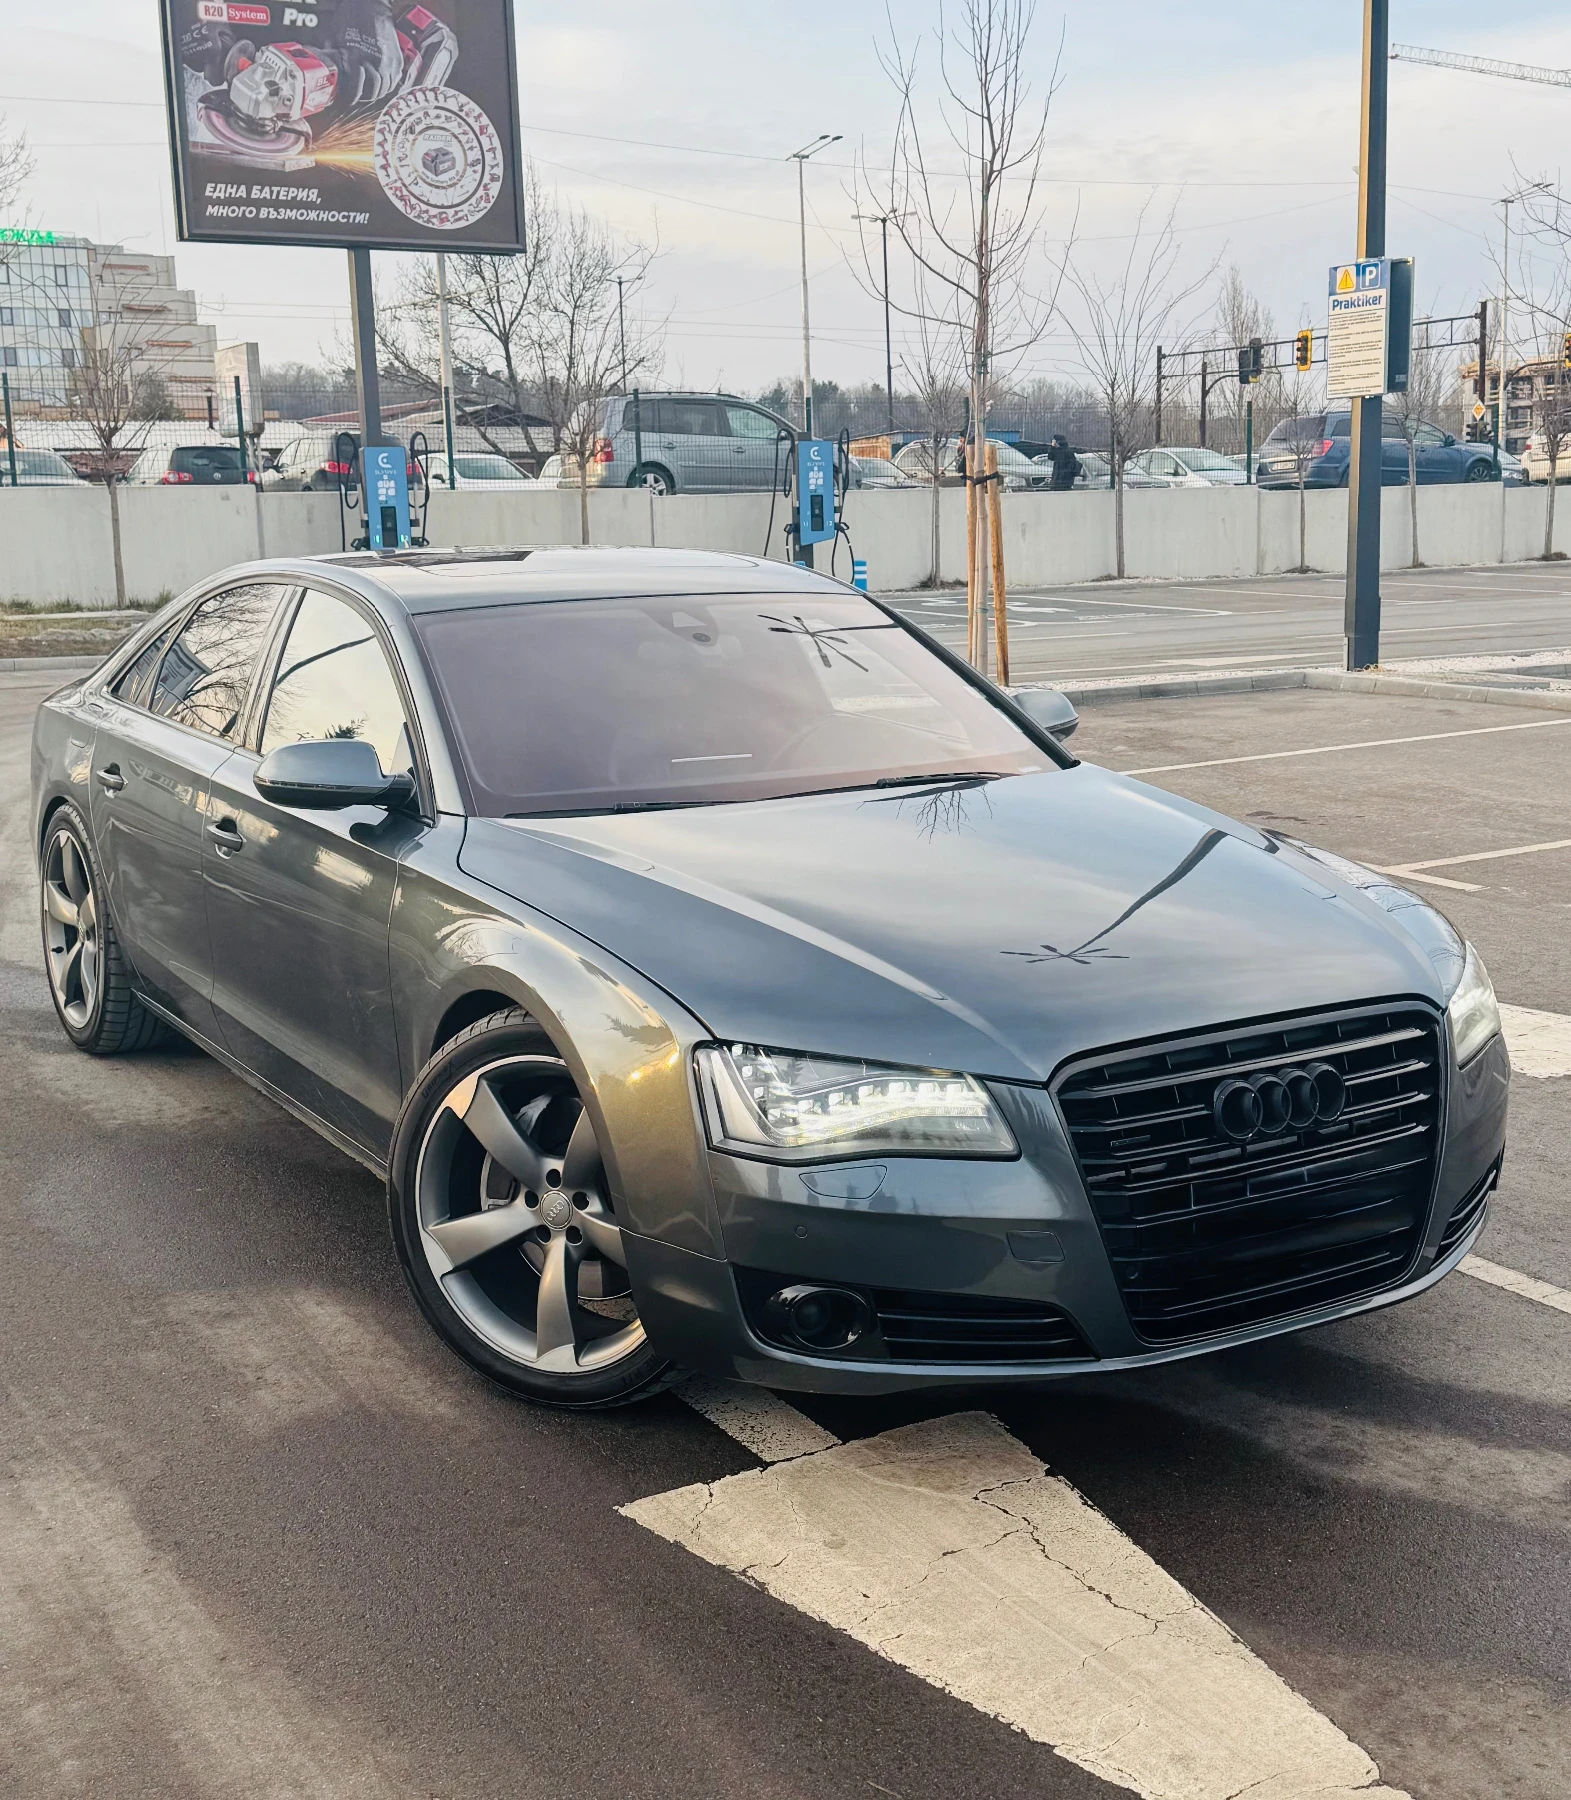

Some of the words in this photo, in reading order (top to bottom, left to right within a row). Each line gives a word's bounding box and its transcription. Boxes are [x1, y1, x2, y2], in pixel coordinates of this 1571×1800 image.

[204, 6, 223, 17] R20
[228, 8, 267, 20] System
[283, 7, 318, 27] Pro
[317, 76, 328, 87] BL
[423, 134, 452, 142] RAIDER
[205, 183, 247, 199] ЕДНА
[251, 186, 322, 204] БАТЕРИЯ,
[206, 205, 257, 218] МНОГО
[259, 208, 369, 224] ВЪЗМОЖНОСТИ!
[1365, 266, 1377, 286] P
[1332, 294, 1382, 311] Praktiker
